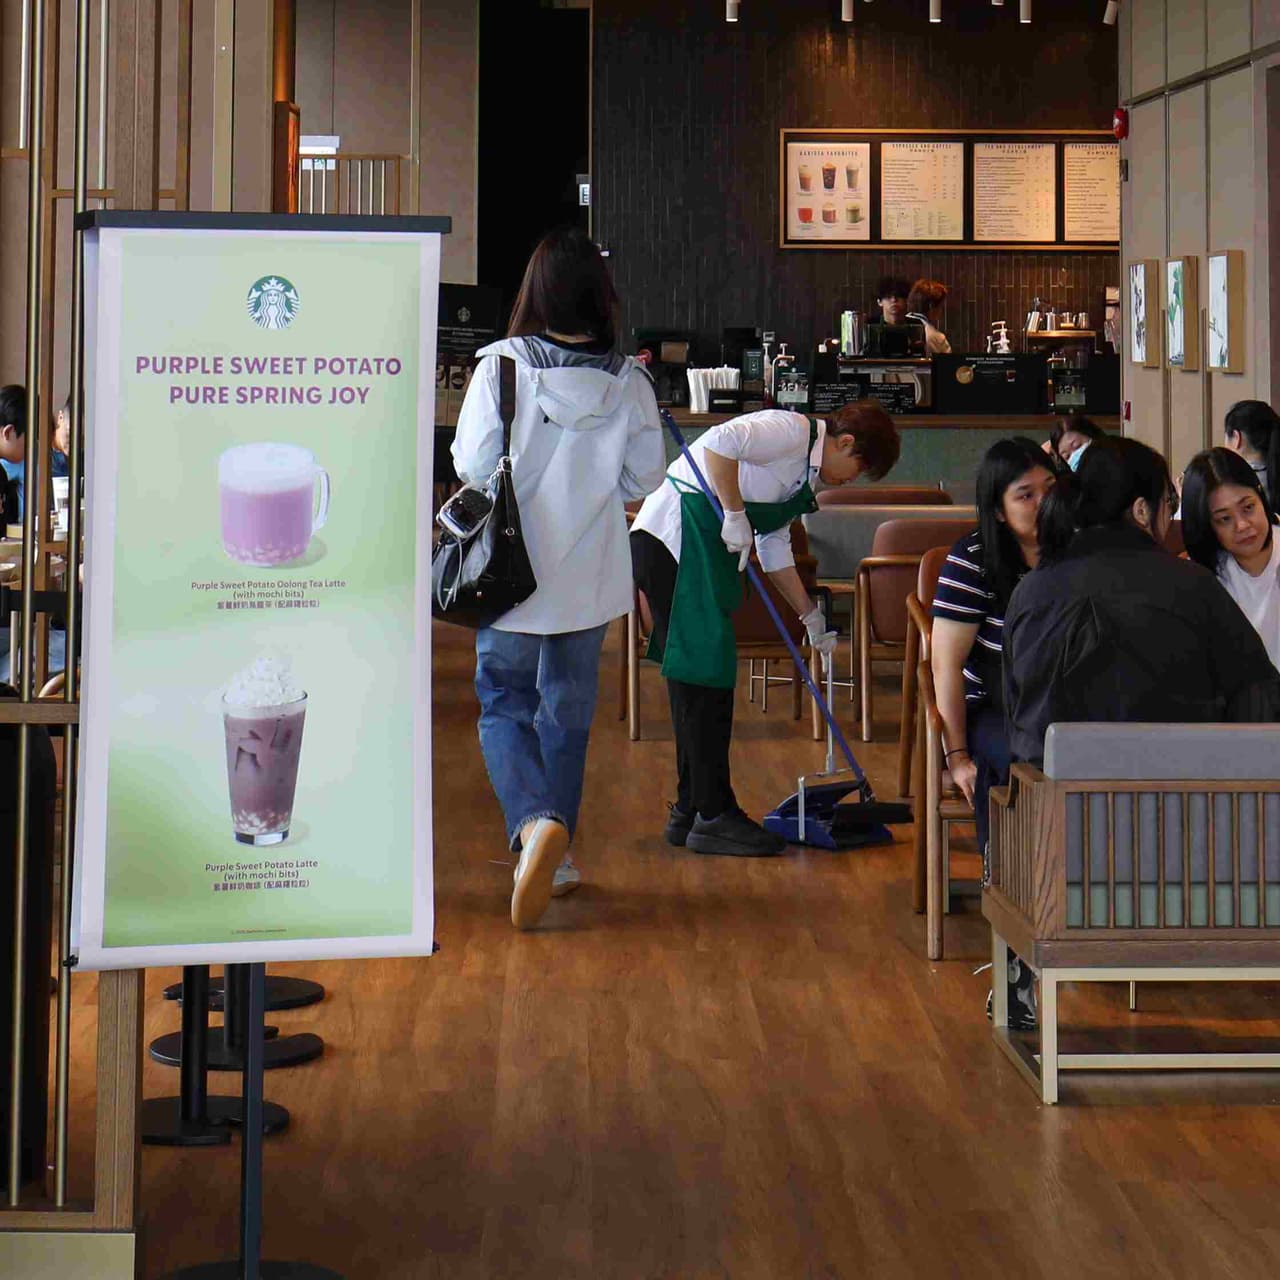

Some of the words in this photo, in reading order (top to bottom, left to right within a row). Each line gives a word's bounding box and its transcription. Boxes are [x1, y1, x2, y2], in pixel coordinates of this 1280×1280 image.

[135, 356, 224, 375] PURPLE
[229, 356, 307, 376] SWEET
[314, 357, 402, 376] POTATO
[170, 386, 229, 404] PURE
[236, 386, 322, 405] SPRING
[328, 387, 370, 404] JOY
[191, 581, 218, 591] Purple
[220, 581, 246, 590] Sweet
[247, 580, 276, 589] Potato
[277, 580, 307, 591] Oolong
[309, 580, 323, 588] Tea
[324, 579, 346, 588] Latte
[233, 590, 255, 600] (with
[257, 590, 283, 599] mochi
[285, 590, 304, 599] bits)
[205, 863, 235, 873] Purple
[235, 862, 262, 871] Sweet
[264, 861, 294, 869] Potato
[295, 860, 319, 868] Latte
[224, 872, 248, 881] (with
[249, 871, 277, 880] mochi
[279, 870, 299, 879] bits)
